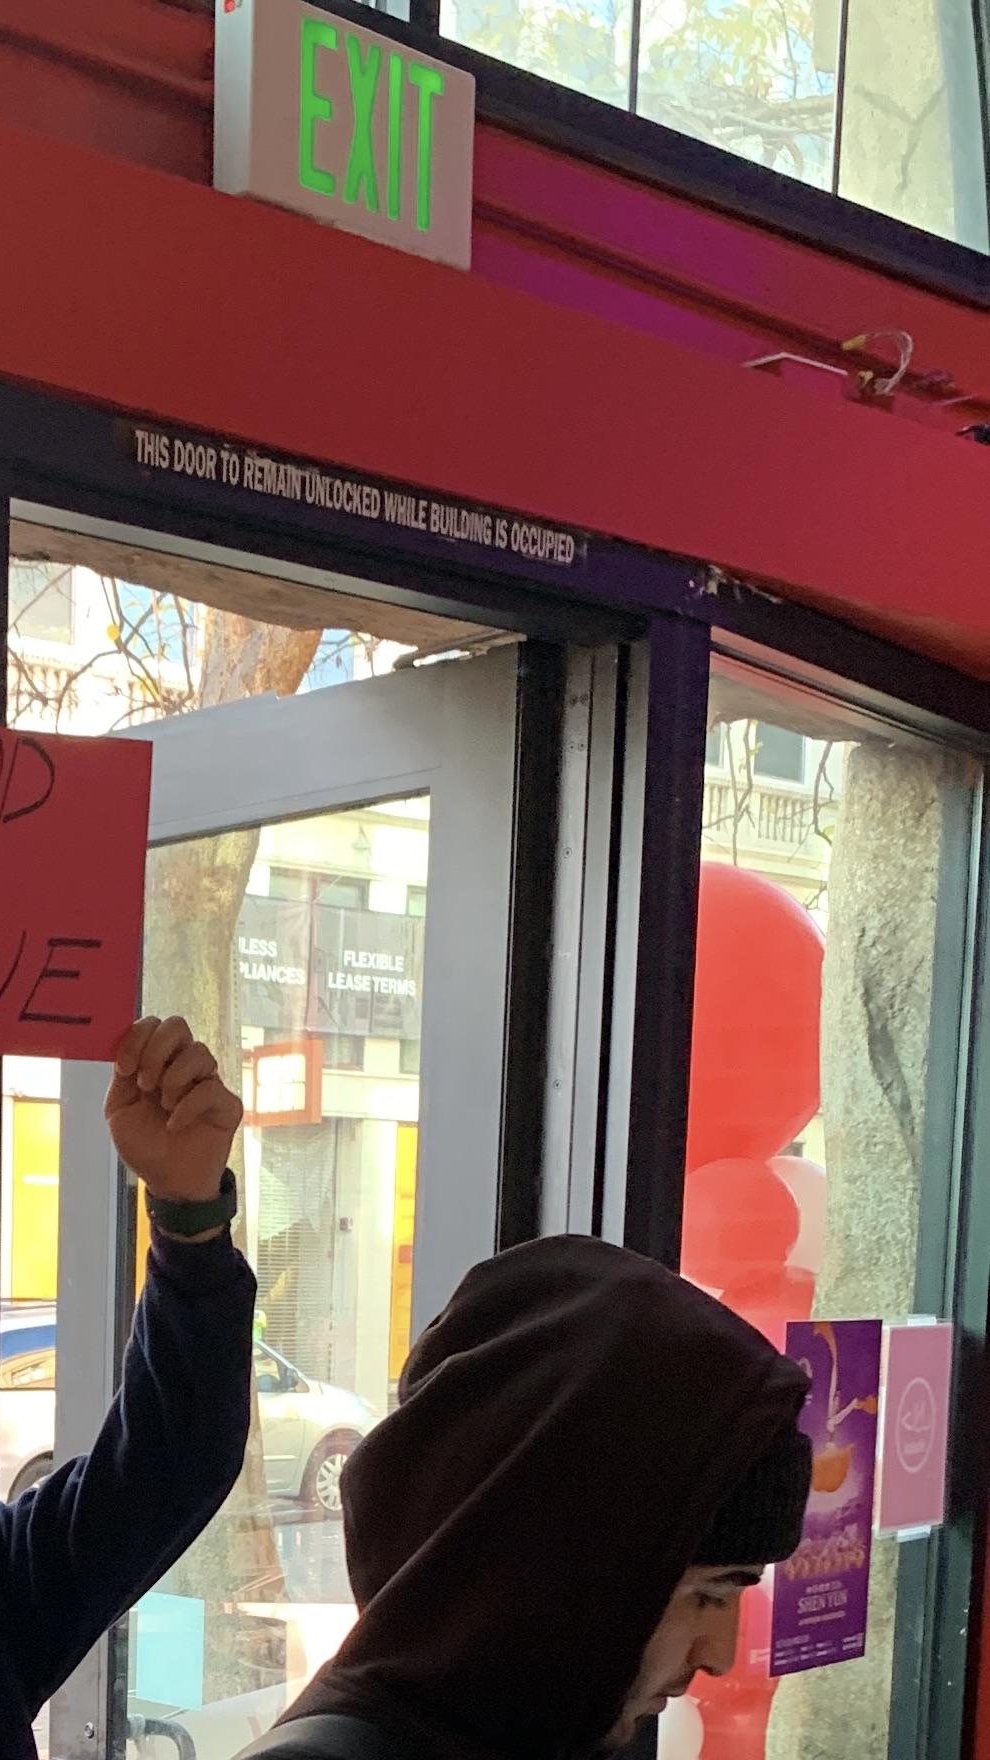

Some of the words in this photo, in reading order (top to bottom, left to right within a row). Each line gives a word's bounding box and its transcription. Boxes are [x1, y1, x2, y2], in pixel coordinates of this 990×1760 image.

[299, 16, 444, 233] EXIT
[135, 429, 170, 468] THIS
[173, 439, 217, 481] DOOR
[220, 450, 240, 486] TO
[243, 456, 302, 500] REMAIN
[304, 472, 381, 519] UNLOCKED
[384, 489, 428, 530] WHILE
[430, 502, 493, 545] BUILDING
[495, 517, 508, 549] IS
[510, 522, 575, 564] OCCUPIED
[328, 971, 371, 993] LEASE
[372, 976, 417, 997] TERMS
[343, 949, 405, 972] FLEXIBLE
